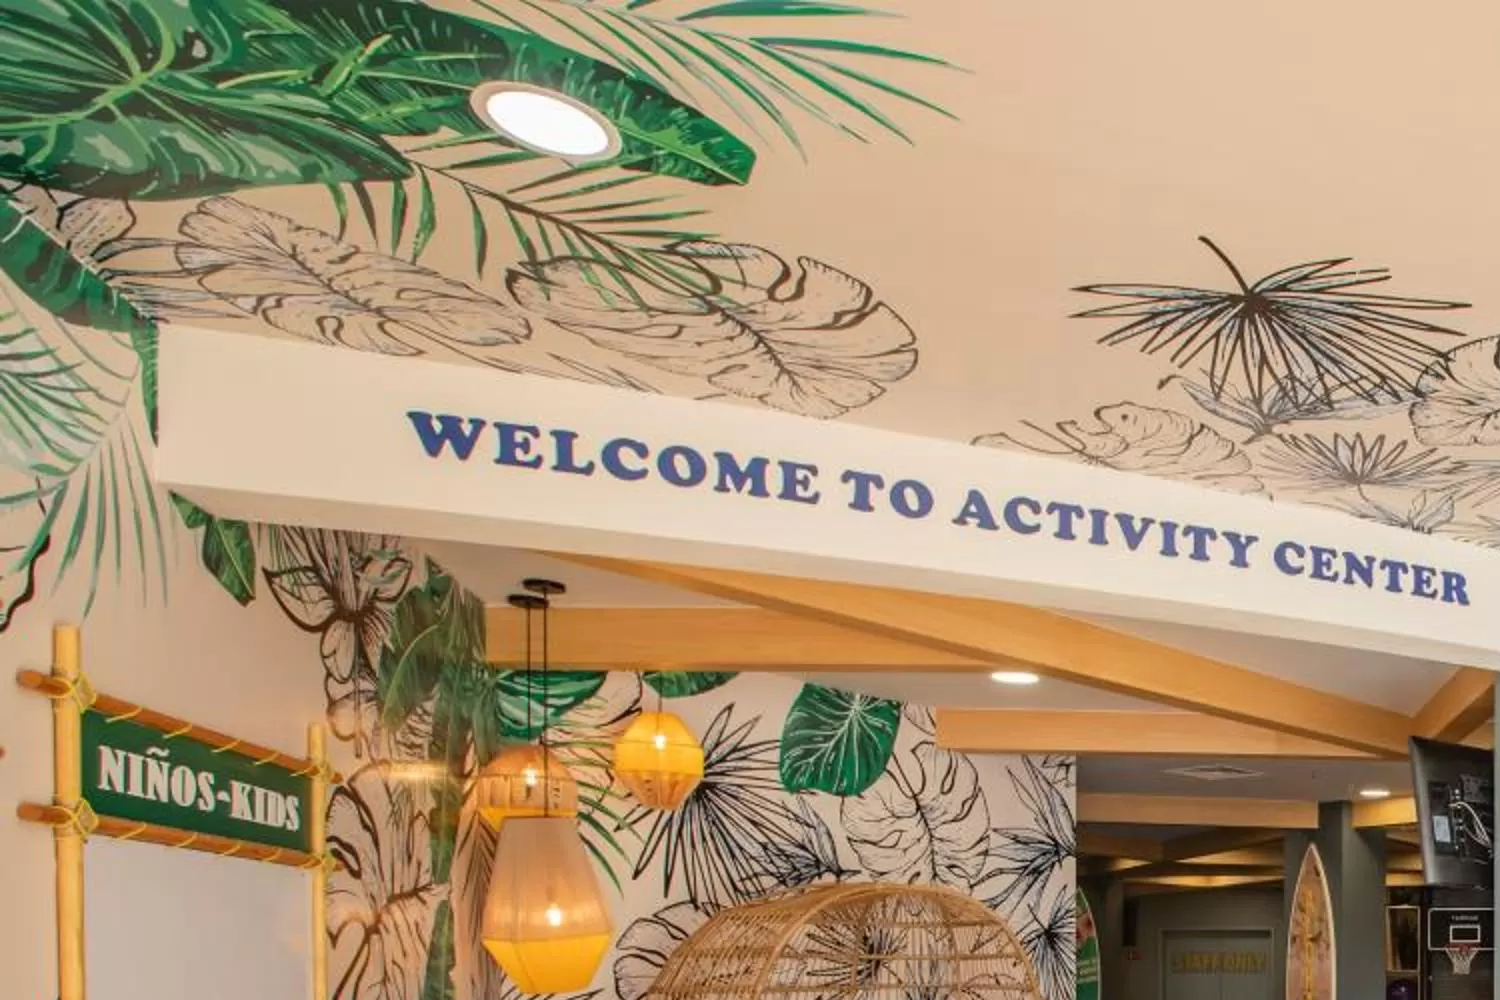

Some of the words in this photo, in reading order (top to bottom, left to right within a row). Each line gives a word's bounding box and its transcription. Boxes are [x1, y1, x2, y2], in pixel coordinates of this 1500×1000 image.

[406, 410, 821, 505] WELCOME
[840, 468, 935, 520] TO
[951, 488, 1260, 569] ACTIVITY
[1273, 540, 1471, 606] CENTER
[97, 744, 300, 832] NIÑOS-KIDS
